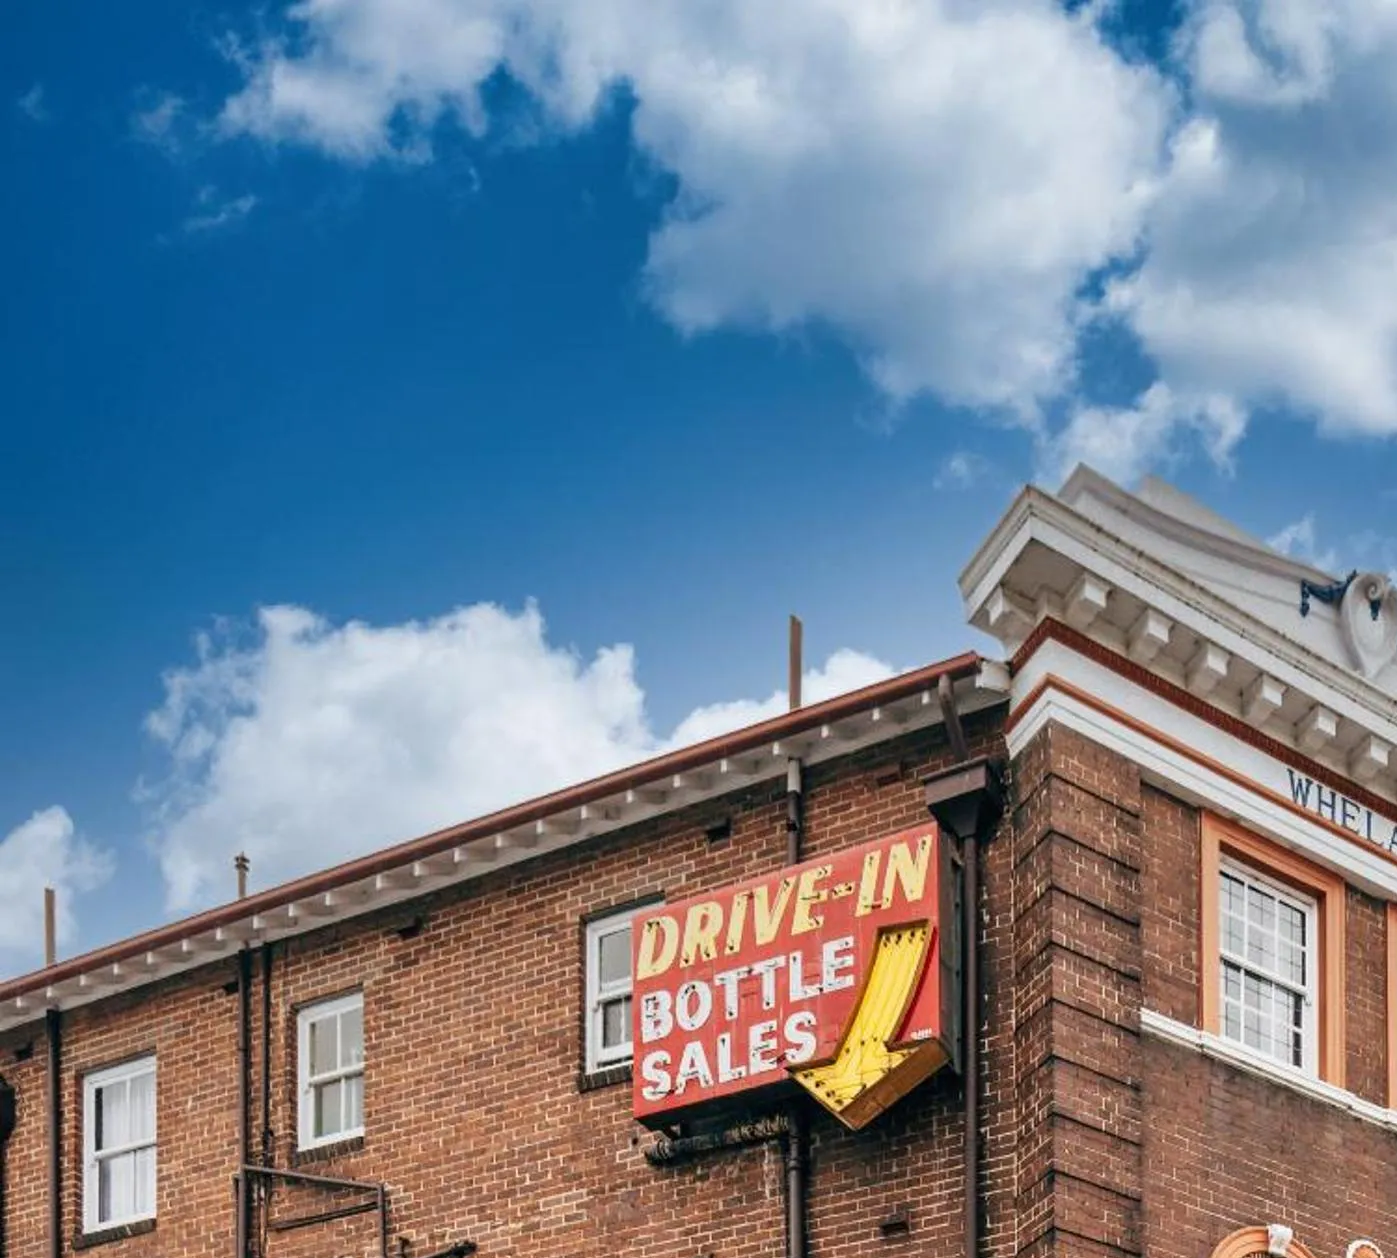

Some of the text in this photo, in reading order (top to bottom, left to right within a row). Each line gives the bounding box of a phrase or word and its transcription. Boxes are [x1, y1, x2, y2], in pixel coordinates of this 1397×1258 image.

[636, 834, 933, 981] DRIVE-IN
[640, 936, 855, 1044] BOTTLE
[641, 1011, 817, 1101] SALES
